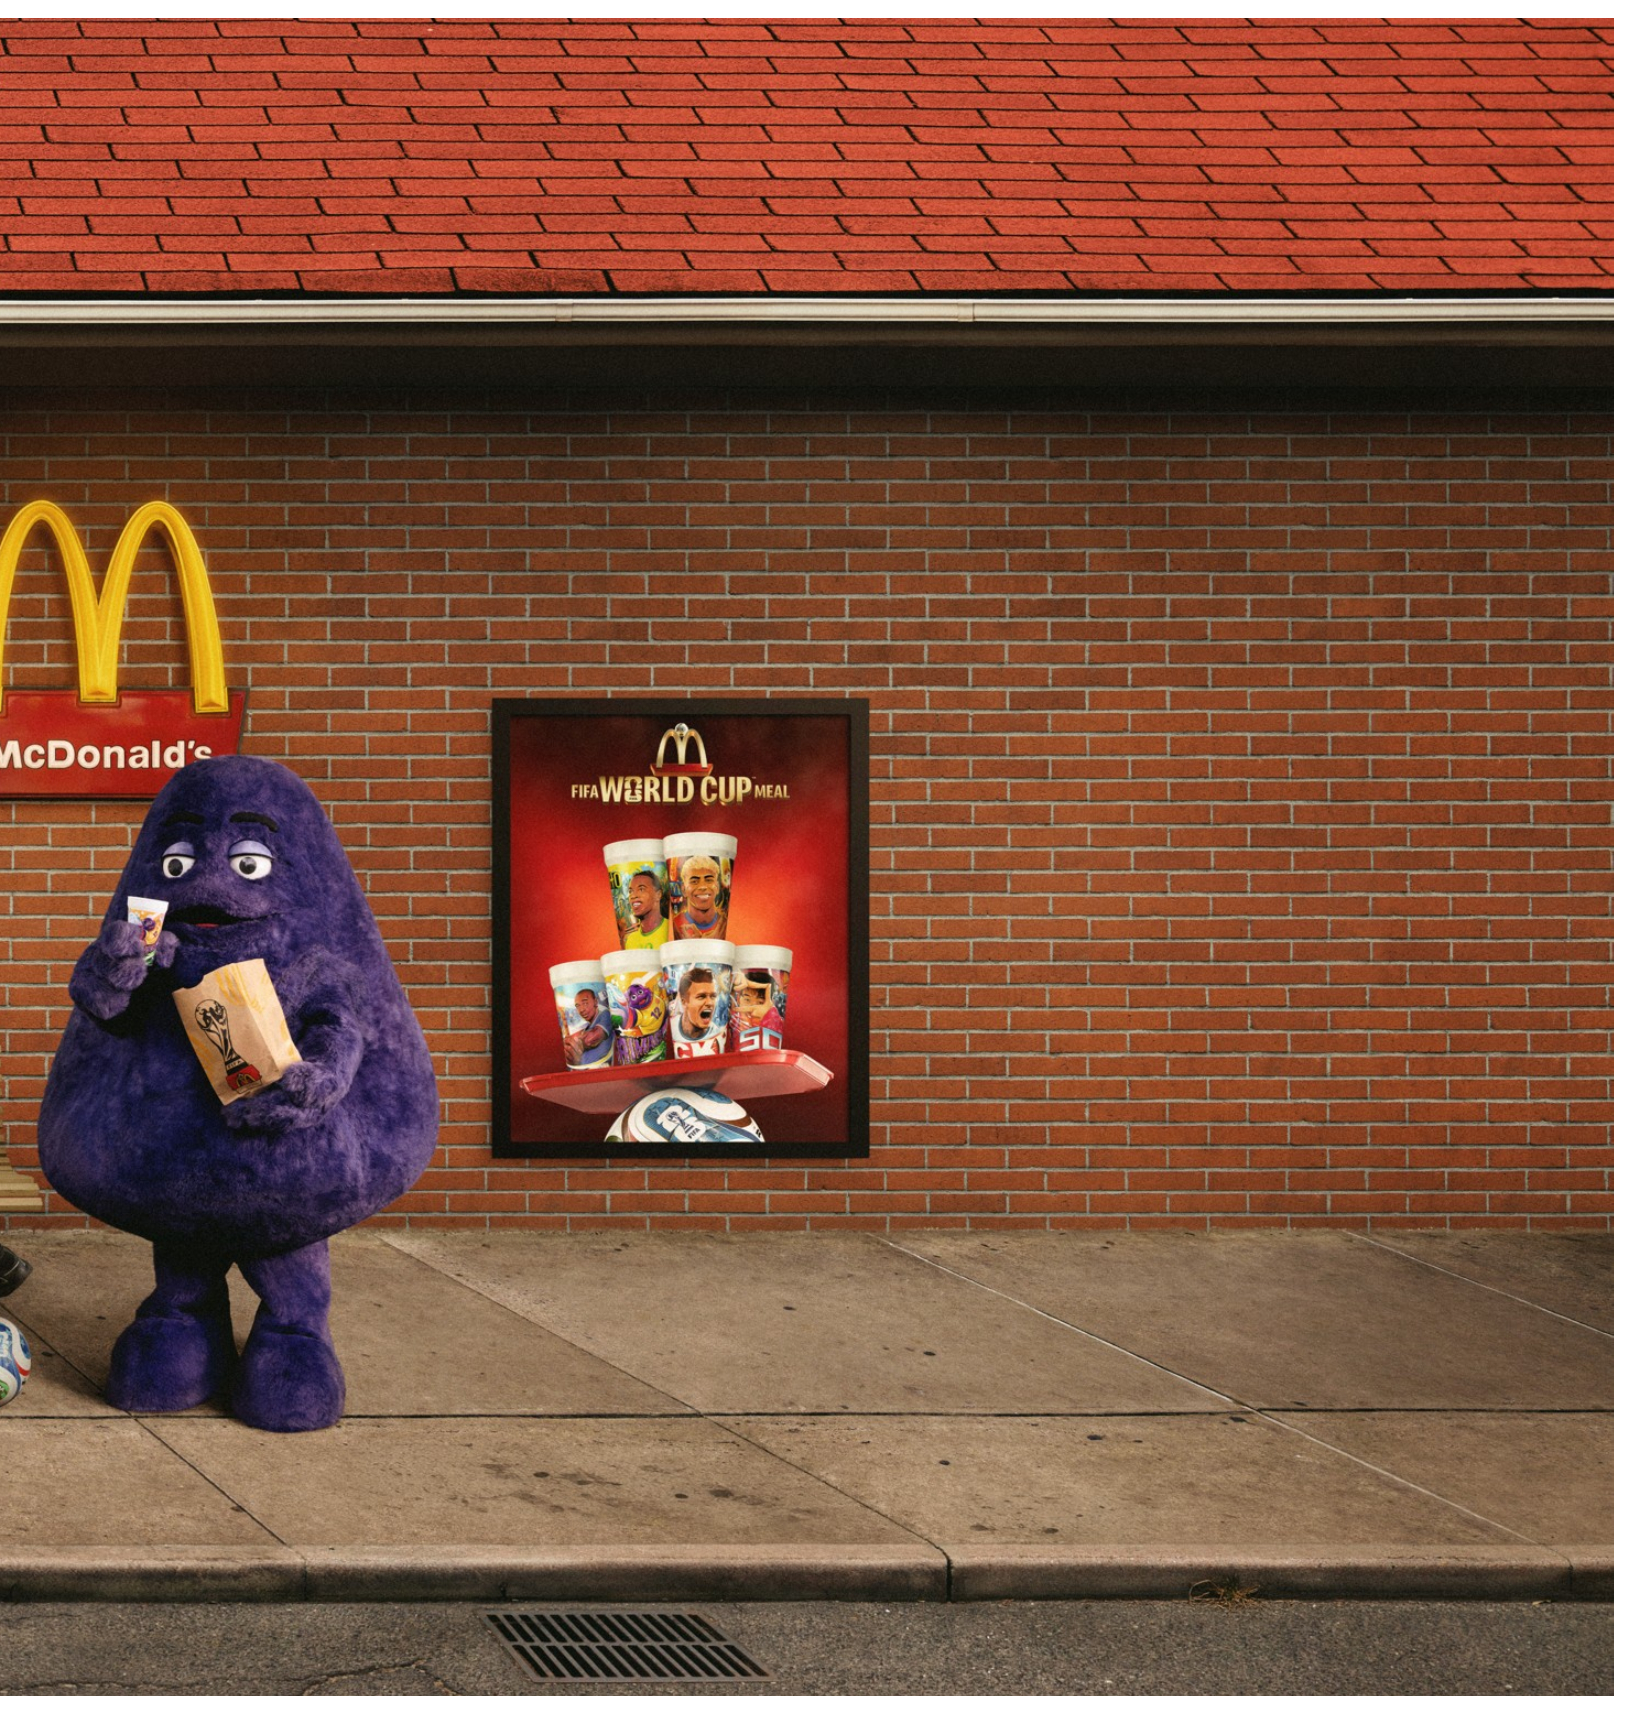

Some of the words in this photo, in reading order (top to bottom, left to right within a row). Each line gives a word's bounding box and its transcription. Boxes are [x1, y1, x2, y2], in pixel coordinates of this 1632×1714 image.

[571, 784, 600, 799] FIFA
[599, 776, 695, 804] WORLD
[700, 776, 753, 805] CUP
[754, 784, 791, 799] MEAL
[650, 1007, 663, 1021] 12
